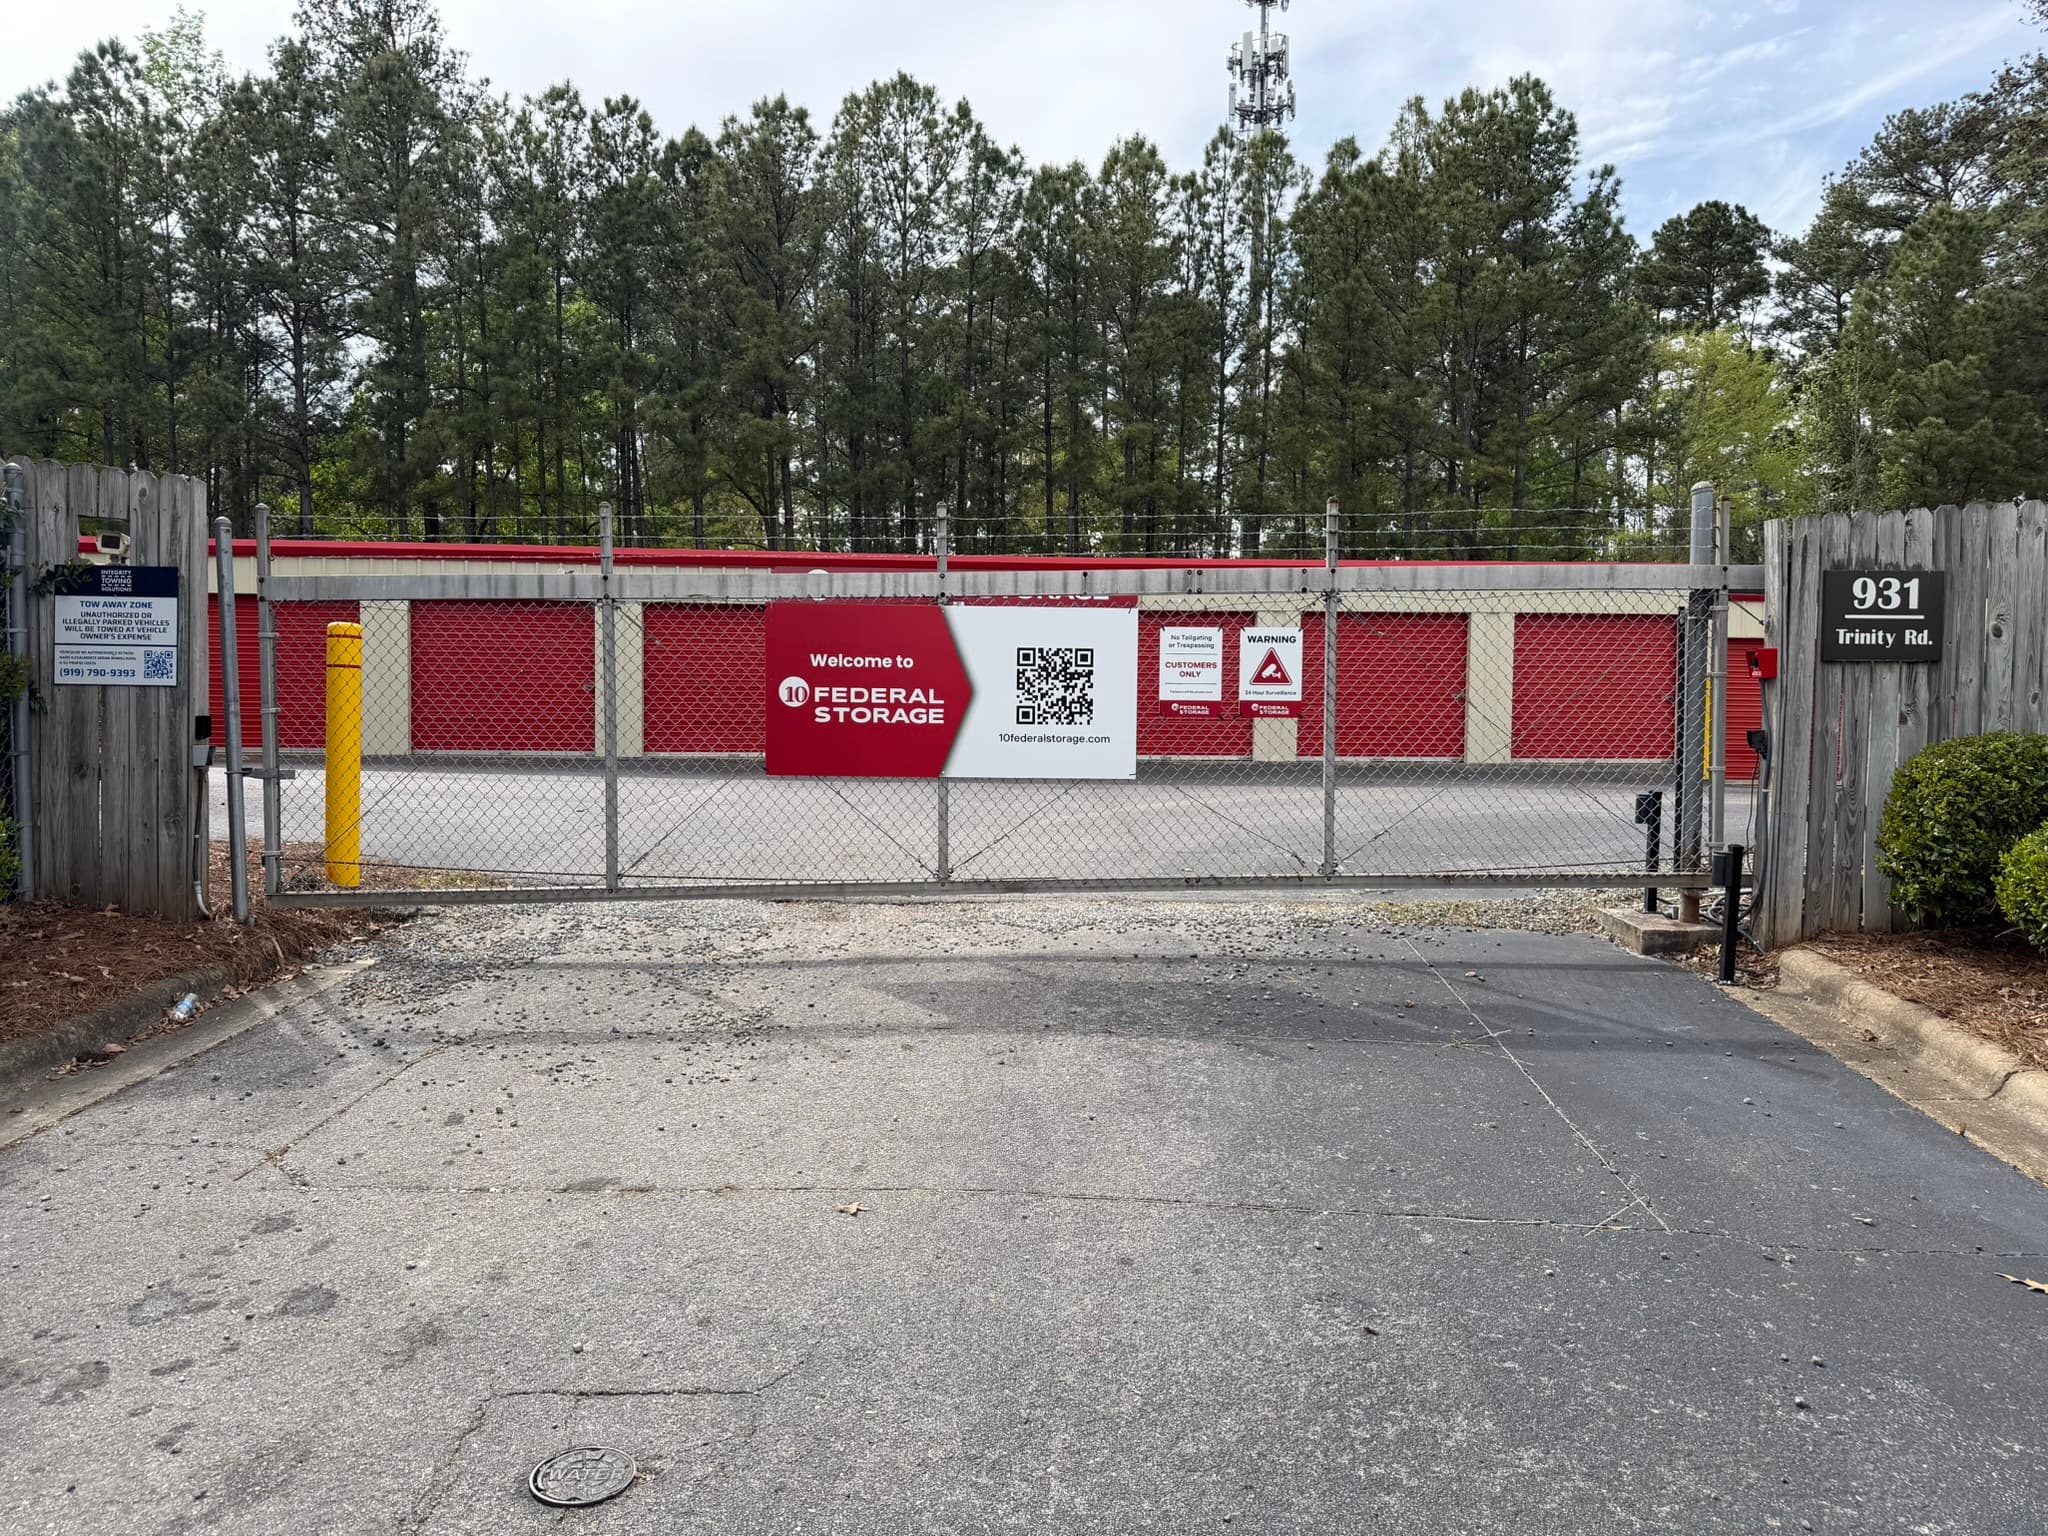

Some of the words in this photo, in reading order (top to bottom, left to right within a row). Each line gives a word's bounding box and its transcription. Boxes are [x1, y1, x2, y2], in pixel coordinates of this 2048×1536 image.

[1852, 577, 1920, 610] 931
[80, 600, 100, 608] TOW
[130, 601, 152, 609] ZONE
[1182, 634, 1212, 642] Tailgating
[1247, 635, 1296, 644] WARNING
[1836, 628, 1896, 648] Trinity
[1905, 629, 1933, 646] Rd.
[1176, 642, 1214, 650] Trespassing
[810, 653, 892, 669] Welcome
[896, 654, 914, 669] to
[1165, 661, 1217, 669] CUSTOMERS
[60, 667, 84, 678] (919)
[87, 668, 136, 678] 790-9393
[784, 685, 807, 704] 10
[814, 686, 945, 704] FEDERAL
[814, 707, 945, 724] STORAGE
[998, 732, 1111, 746] 10federalstorage.com
[548, 1468, 626, 1482] WATER
